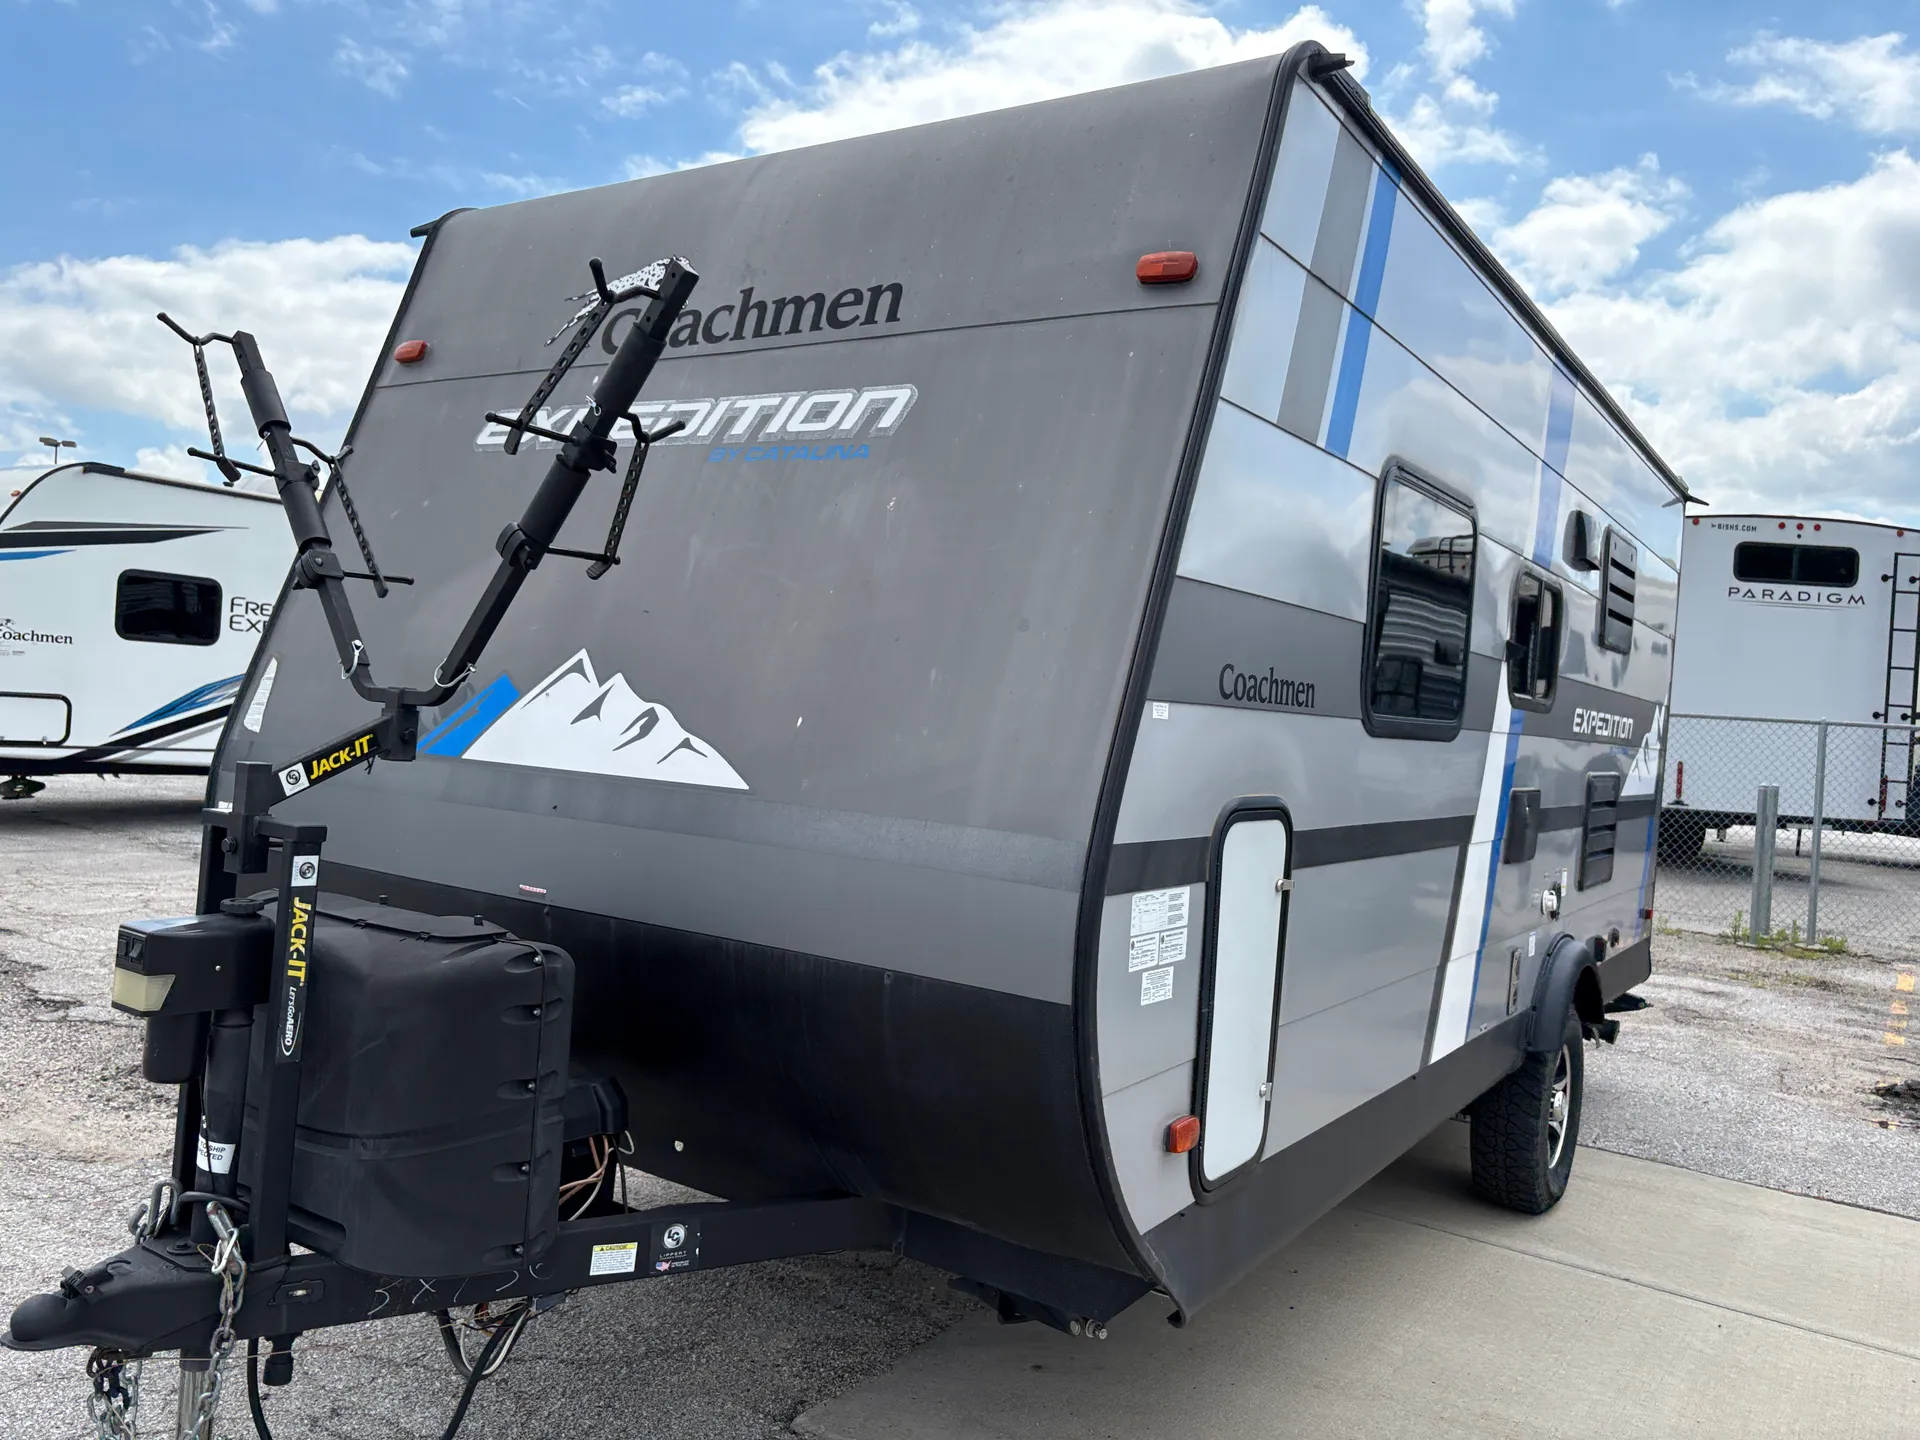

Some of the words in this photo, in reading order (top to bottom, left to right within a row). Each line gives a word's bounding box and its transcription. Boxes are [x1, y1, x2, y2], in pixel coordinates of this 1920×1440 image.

[600, 281, 904, 356] Cachmen
[708, 447, 744, 462] BY
[744, 443, 870, 462] CATALINA
[1727, 586, 1866, 606] PARADIGM
[1218, 662, 1316, 709] Coachmen
[1572, 707, 1634, 740] EXPEDITION
[310, 734, 372, 780] JACK-IT
[287, 896, 312, 984] JACK-IT
[209, 1145, 226, 1154] SHIP
